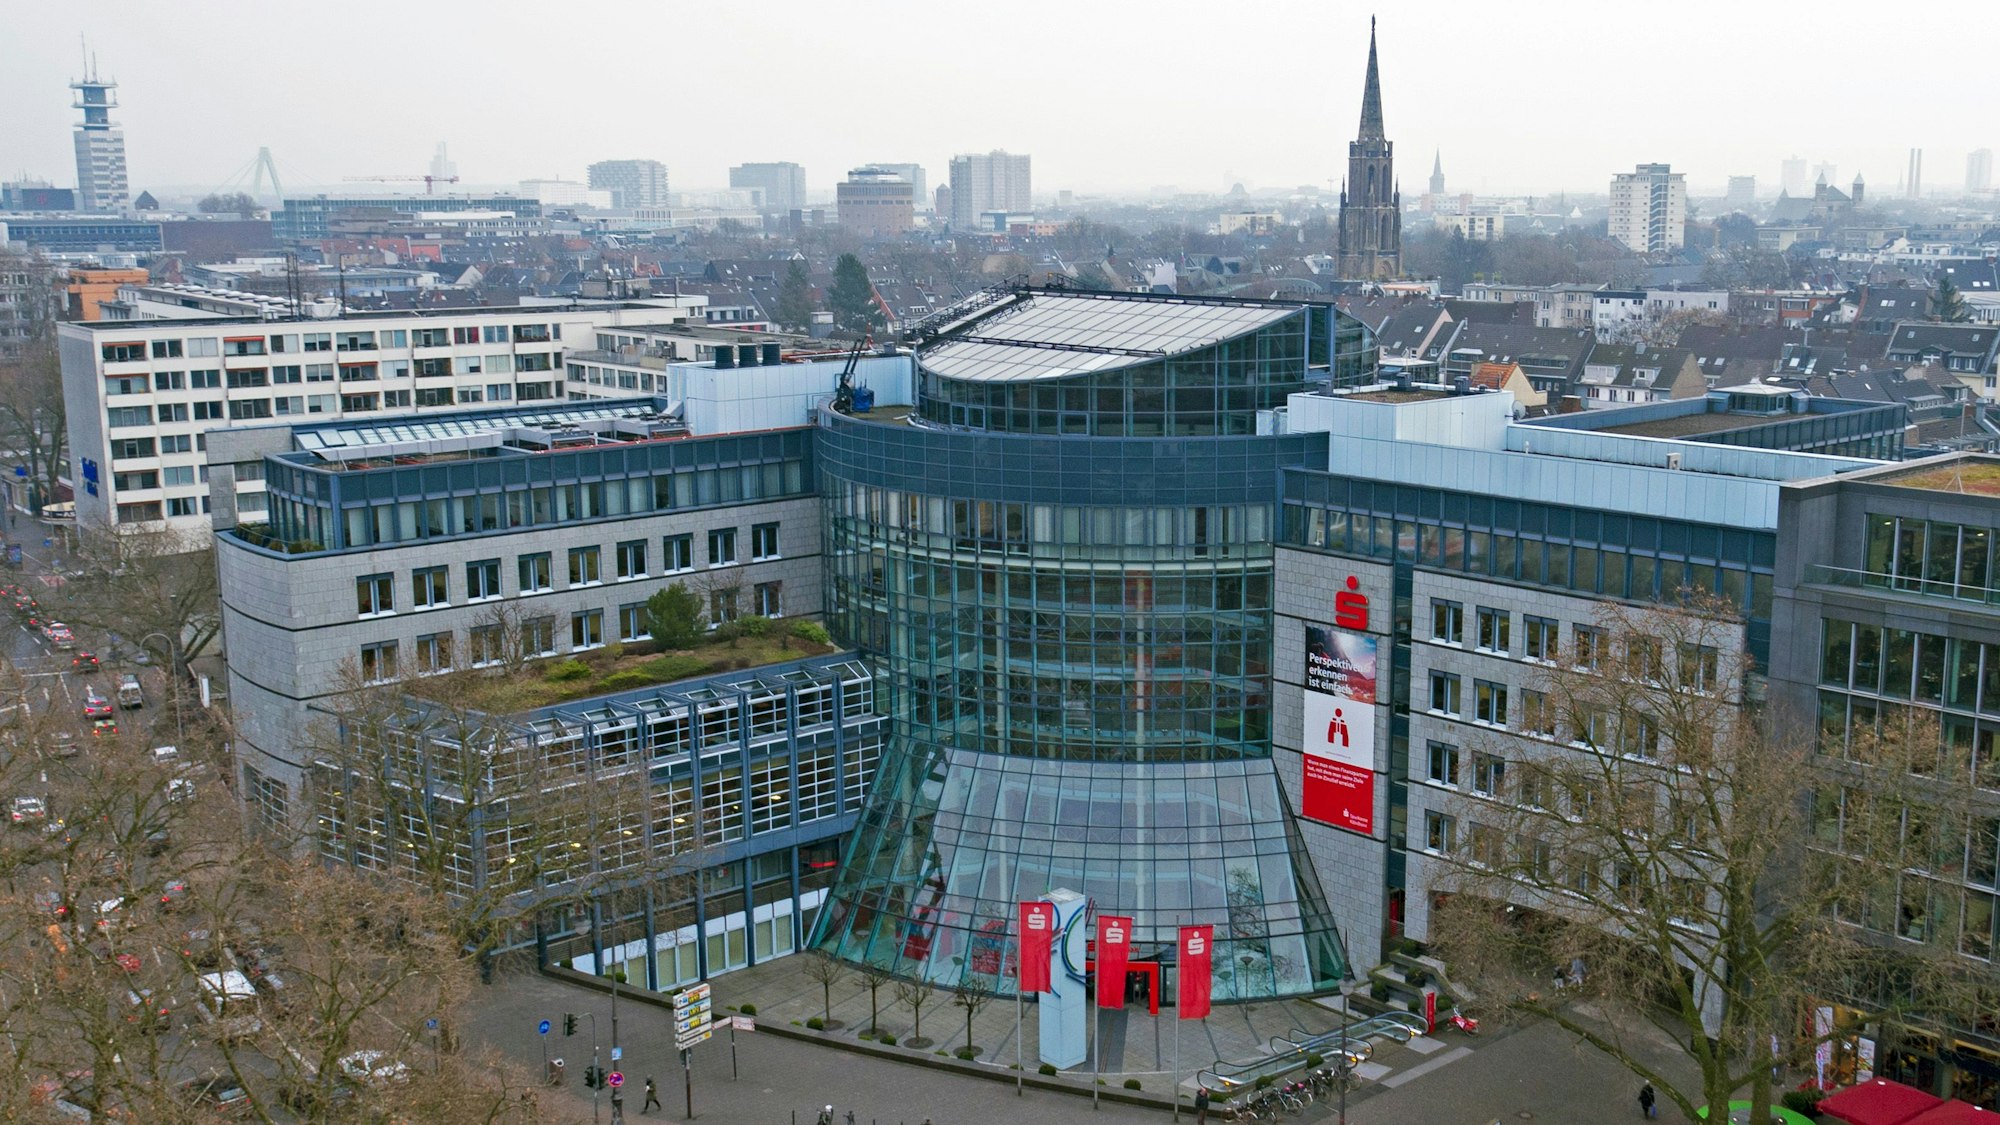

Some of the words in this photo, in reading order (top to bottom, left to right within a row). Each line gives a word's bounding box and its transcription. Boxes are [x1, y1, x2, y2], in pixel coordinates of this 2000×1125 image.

[1309, 652, 1362, 672] Perspektiven
[1309, 666, 1348, 682] erkennen
[1309, 676, 1320, 688] ist
[1321, 680, 1354, 695] einfach.
